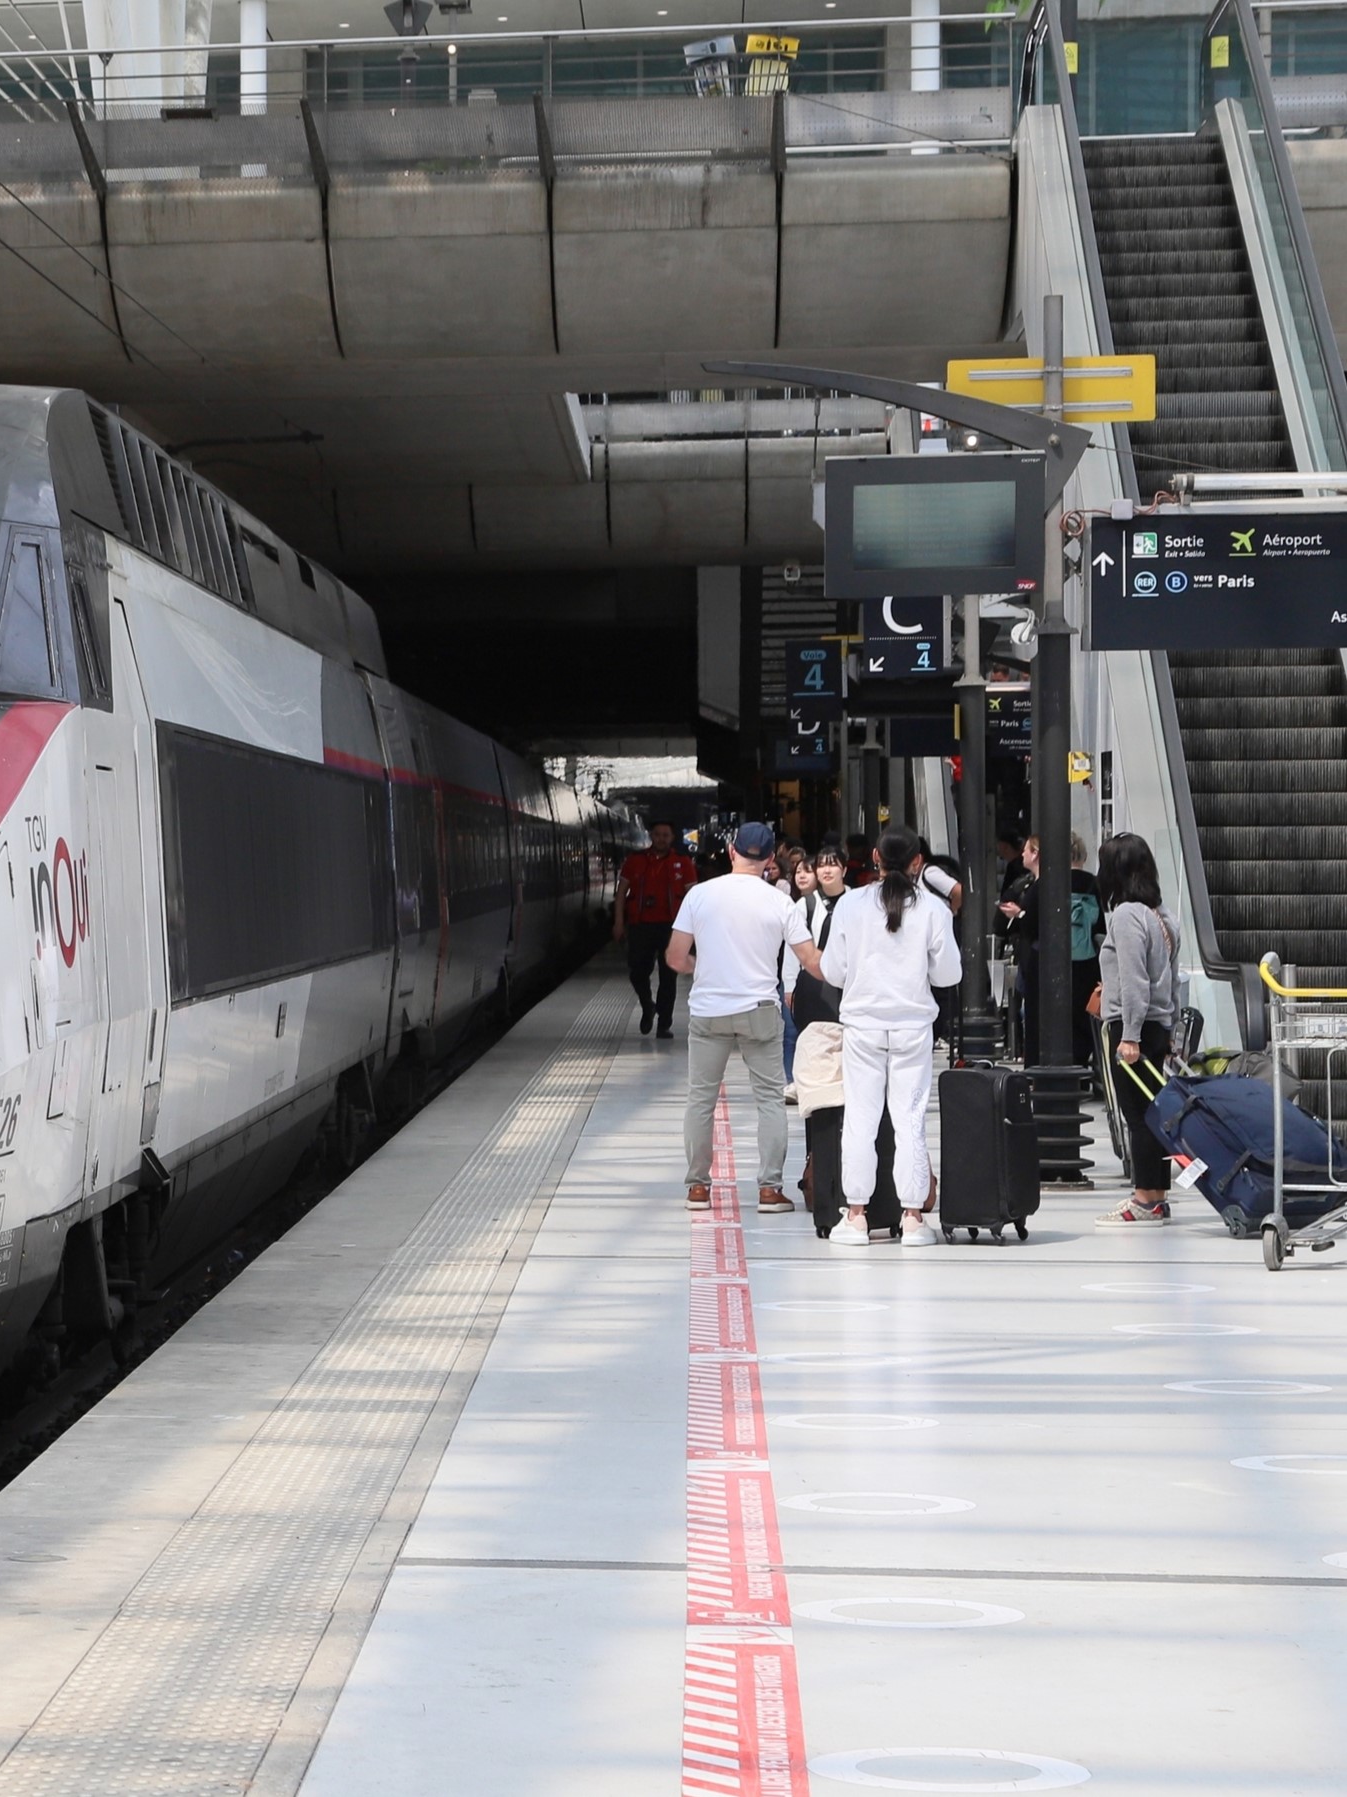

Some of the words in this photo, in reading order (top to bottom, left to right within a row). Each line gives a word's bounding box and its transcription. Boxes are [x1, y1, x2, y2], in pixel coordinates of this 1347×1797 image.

[1165, 535, 1204, 548] Sortie
[1262, 533, 1322, 548] Aéroport
[1164, 550, 1178, 558] Exit
[1262, 549, 1287, 557] Airport
[1292, 548, 1331, 557] Aeropuerto
[1137, 577, 1154, 587] RER
[1172, 576, 1181, 588] B
[1217, 574, 1255, 588] Paris
[803, 651, 824, 660] Voie
[917, 650, 930, 668] 4
[804, 663, 824, 690] 4
[25, 815, 47, 852] TGV
